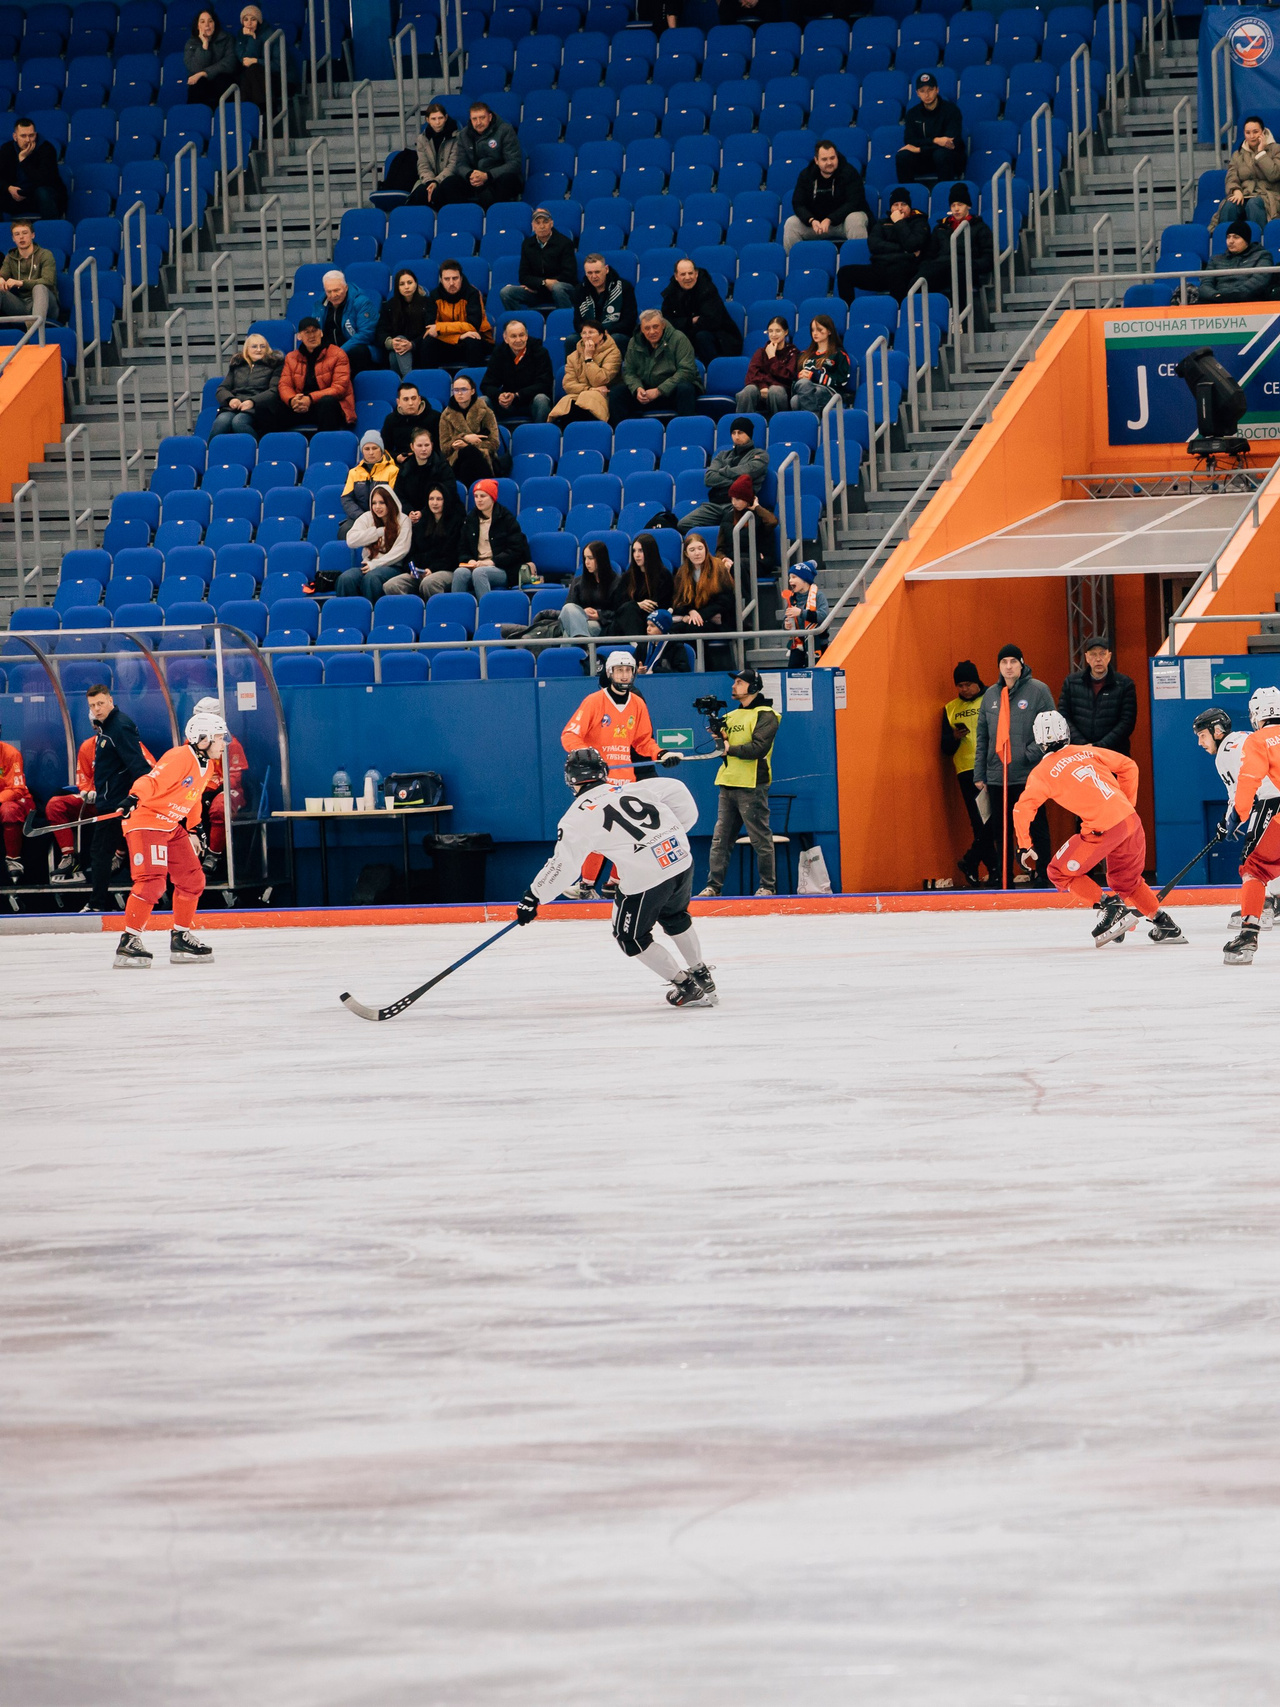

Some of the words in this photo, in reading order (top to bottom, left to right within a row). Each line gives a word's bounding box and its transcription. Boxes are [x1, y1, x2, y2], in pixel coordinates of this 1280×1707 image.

[1112, 318, 1189, 334] ВОСТОЧНАЯ
[1190, 316, 1248, 331] ТРИБУНА
[1126, 365, 1149, 430] J
[1071, 764, 1116, 800] 7
[602, 795, 661, 842] 19
